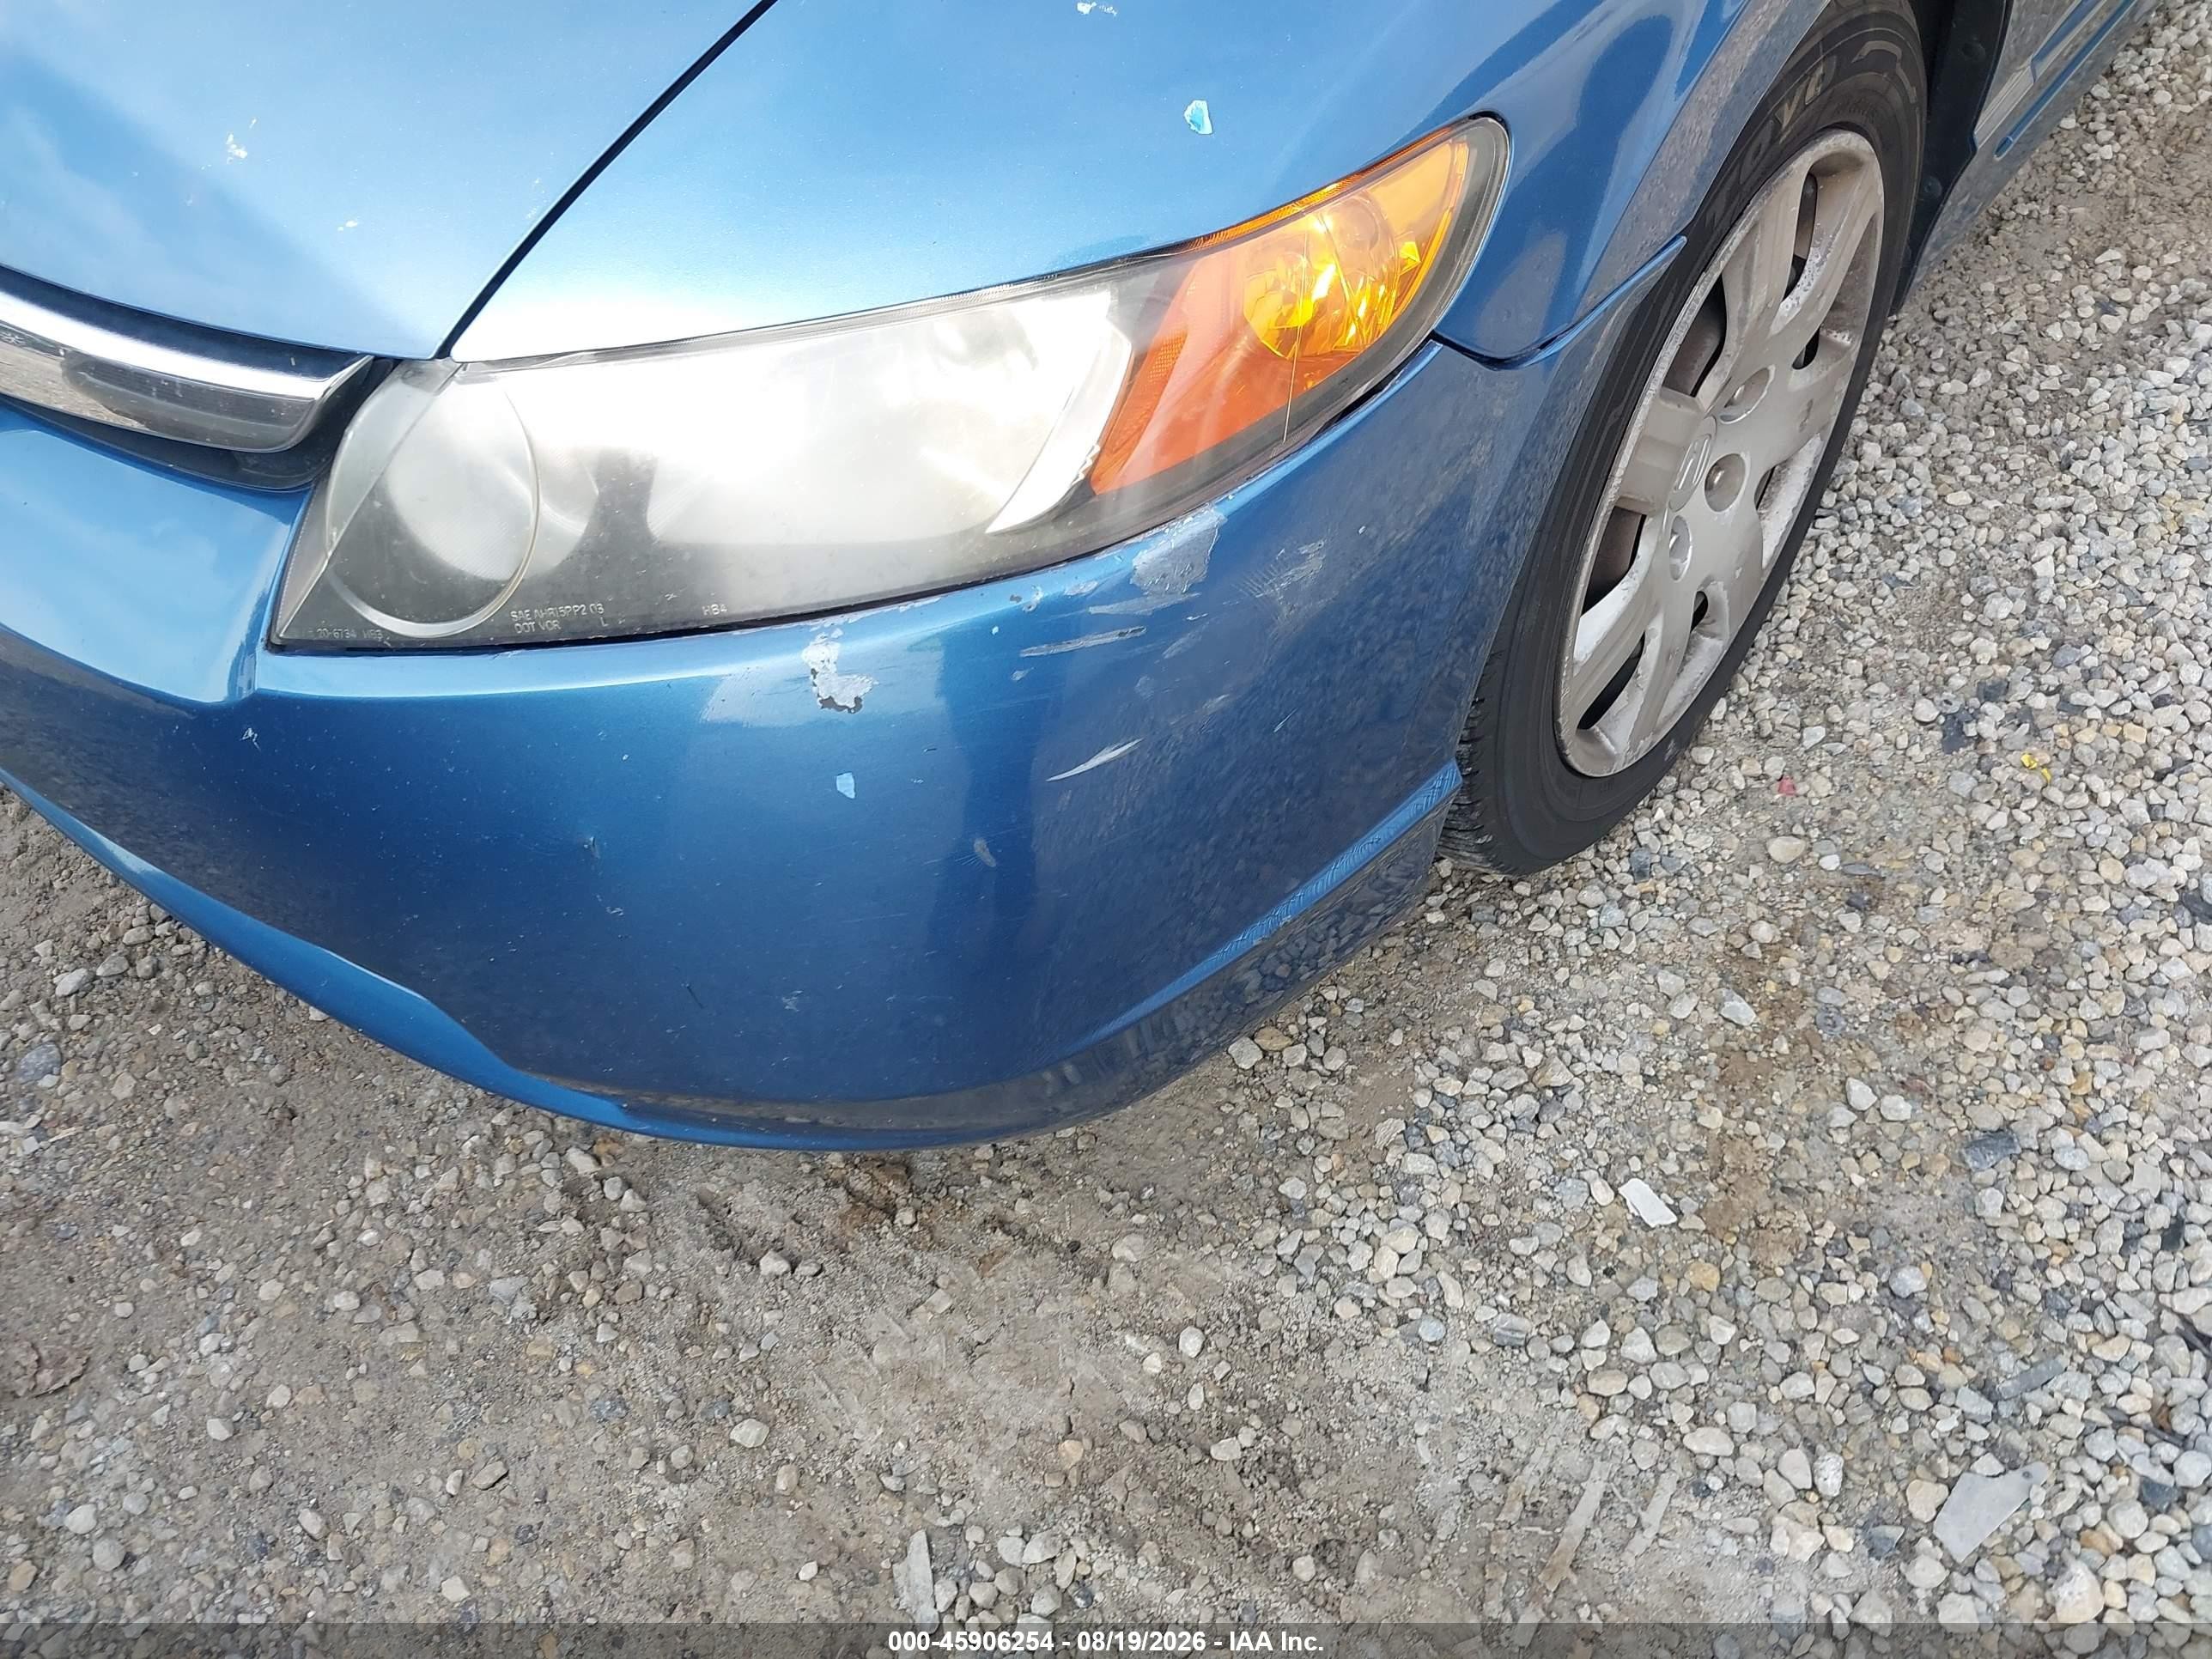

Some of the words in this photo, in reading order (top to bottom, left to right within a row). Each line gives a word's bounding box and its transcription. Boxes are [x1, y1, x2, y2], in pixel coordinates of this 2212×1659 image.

[510, 609, 532, 622] SAE
[589, 603, 605, 615] 03
[702, 603, 728, 616] HB4
[514, 621, 536, 634] DOT
[538, 619, 562, 632] VOR
